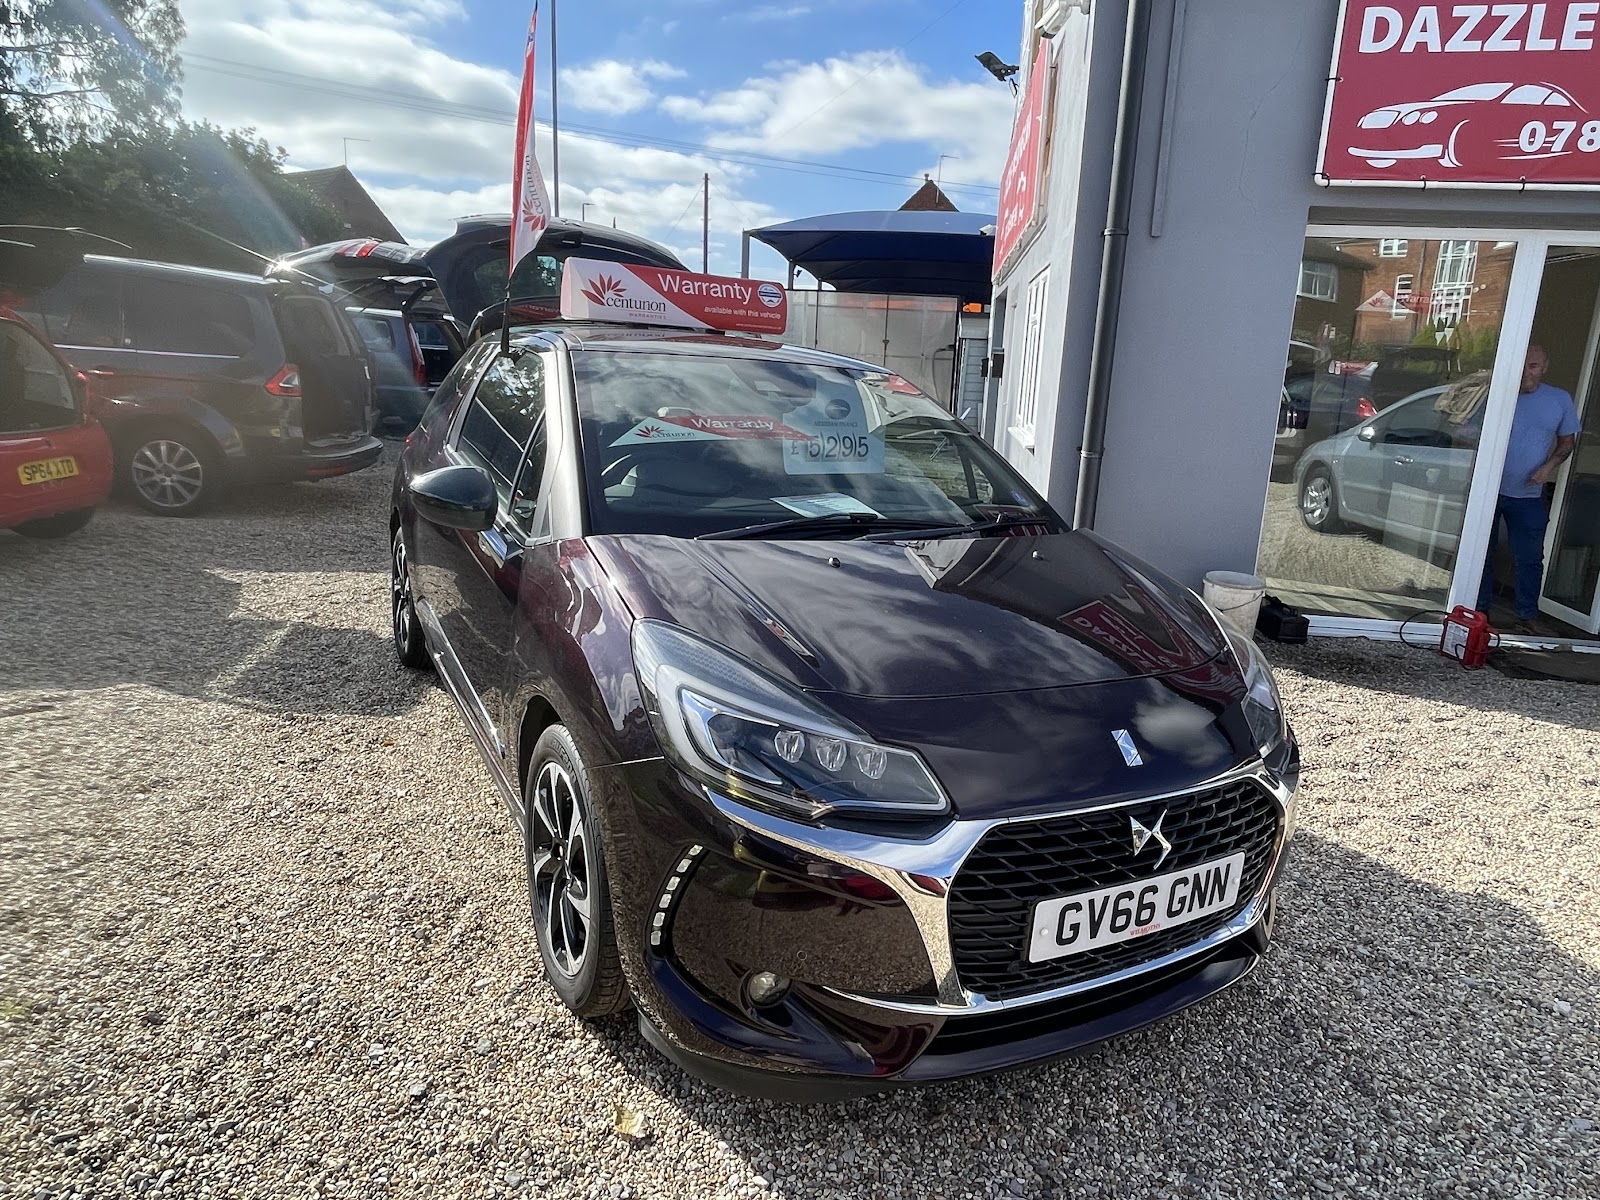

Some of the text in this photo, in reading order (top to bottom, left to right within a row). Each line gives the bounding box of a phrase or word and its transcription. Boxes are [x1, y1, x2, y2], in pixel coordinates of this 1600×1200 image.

[1358, 2, 1600, 53] DAZZLE
[1518, 120, 1600, 154] 078
[657, 273, 752, 305] Warranty
[704, 306, 732, 315] available
[747, 309, 759, 317] this
[759, 311, 781, 319] vehicle
[691, 418, 774, 431] Warranty
[809, 434, 869, 457] 5295
[23, 458, 74, 481] SP64 XTD
[1055, 863, 1231, 946] GV66 GNN
